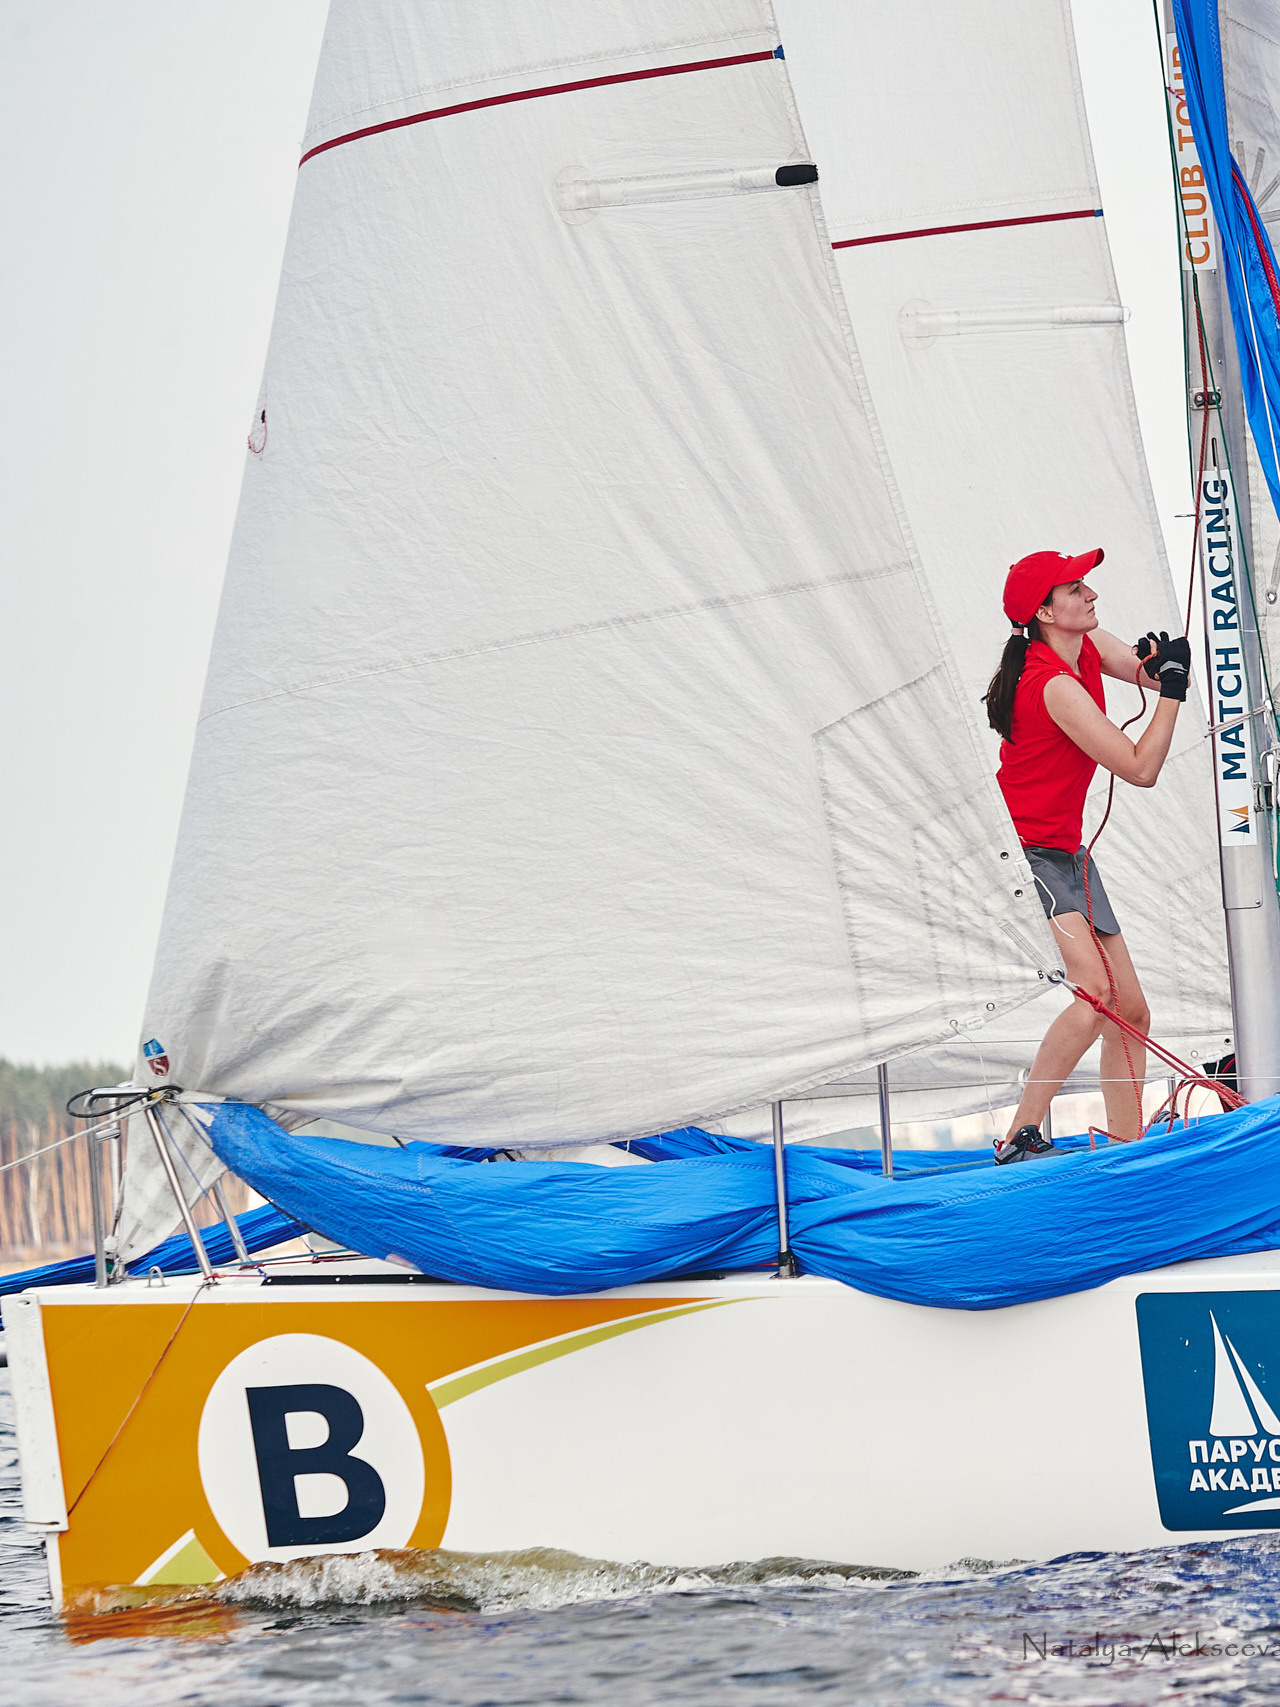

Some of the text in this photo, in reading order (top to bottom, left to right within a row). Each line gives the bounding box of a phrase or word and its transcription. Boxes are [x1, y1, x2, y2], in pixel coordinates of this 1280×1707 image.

[1180, 164, 1210, 265] CLUB
[1202, 479, 1247, 780] MATCH RACING
[245, 1383, 386, 1548] B
